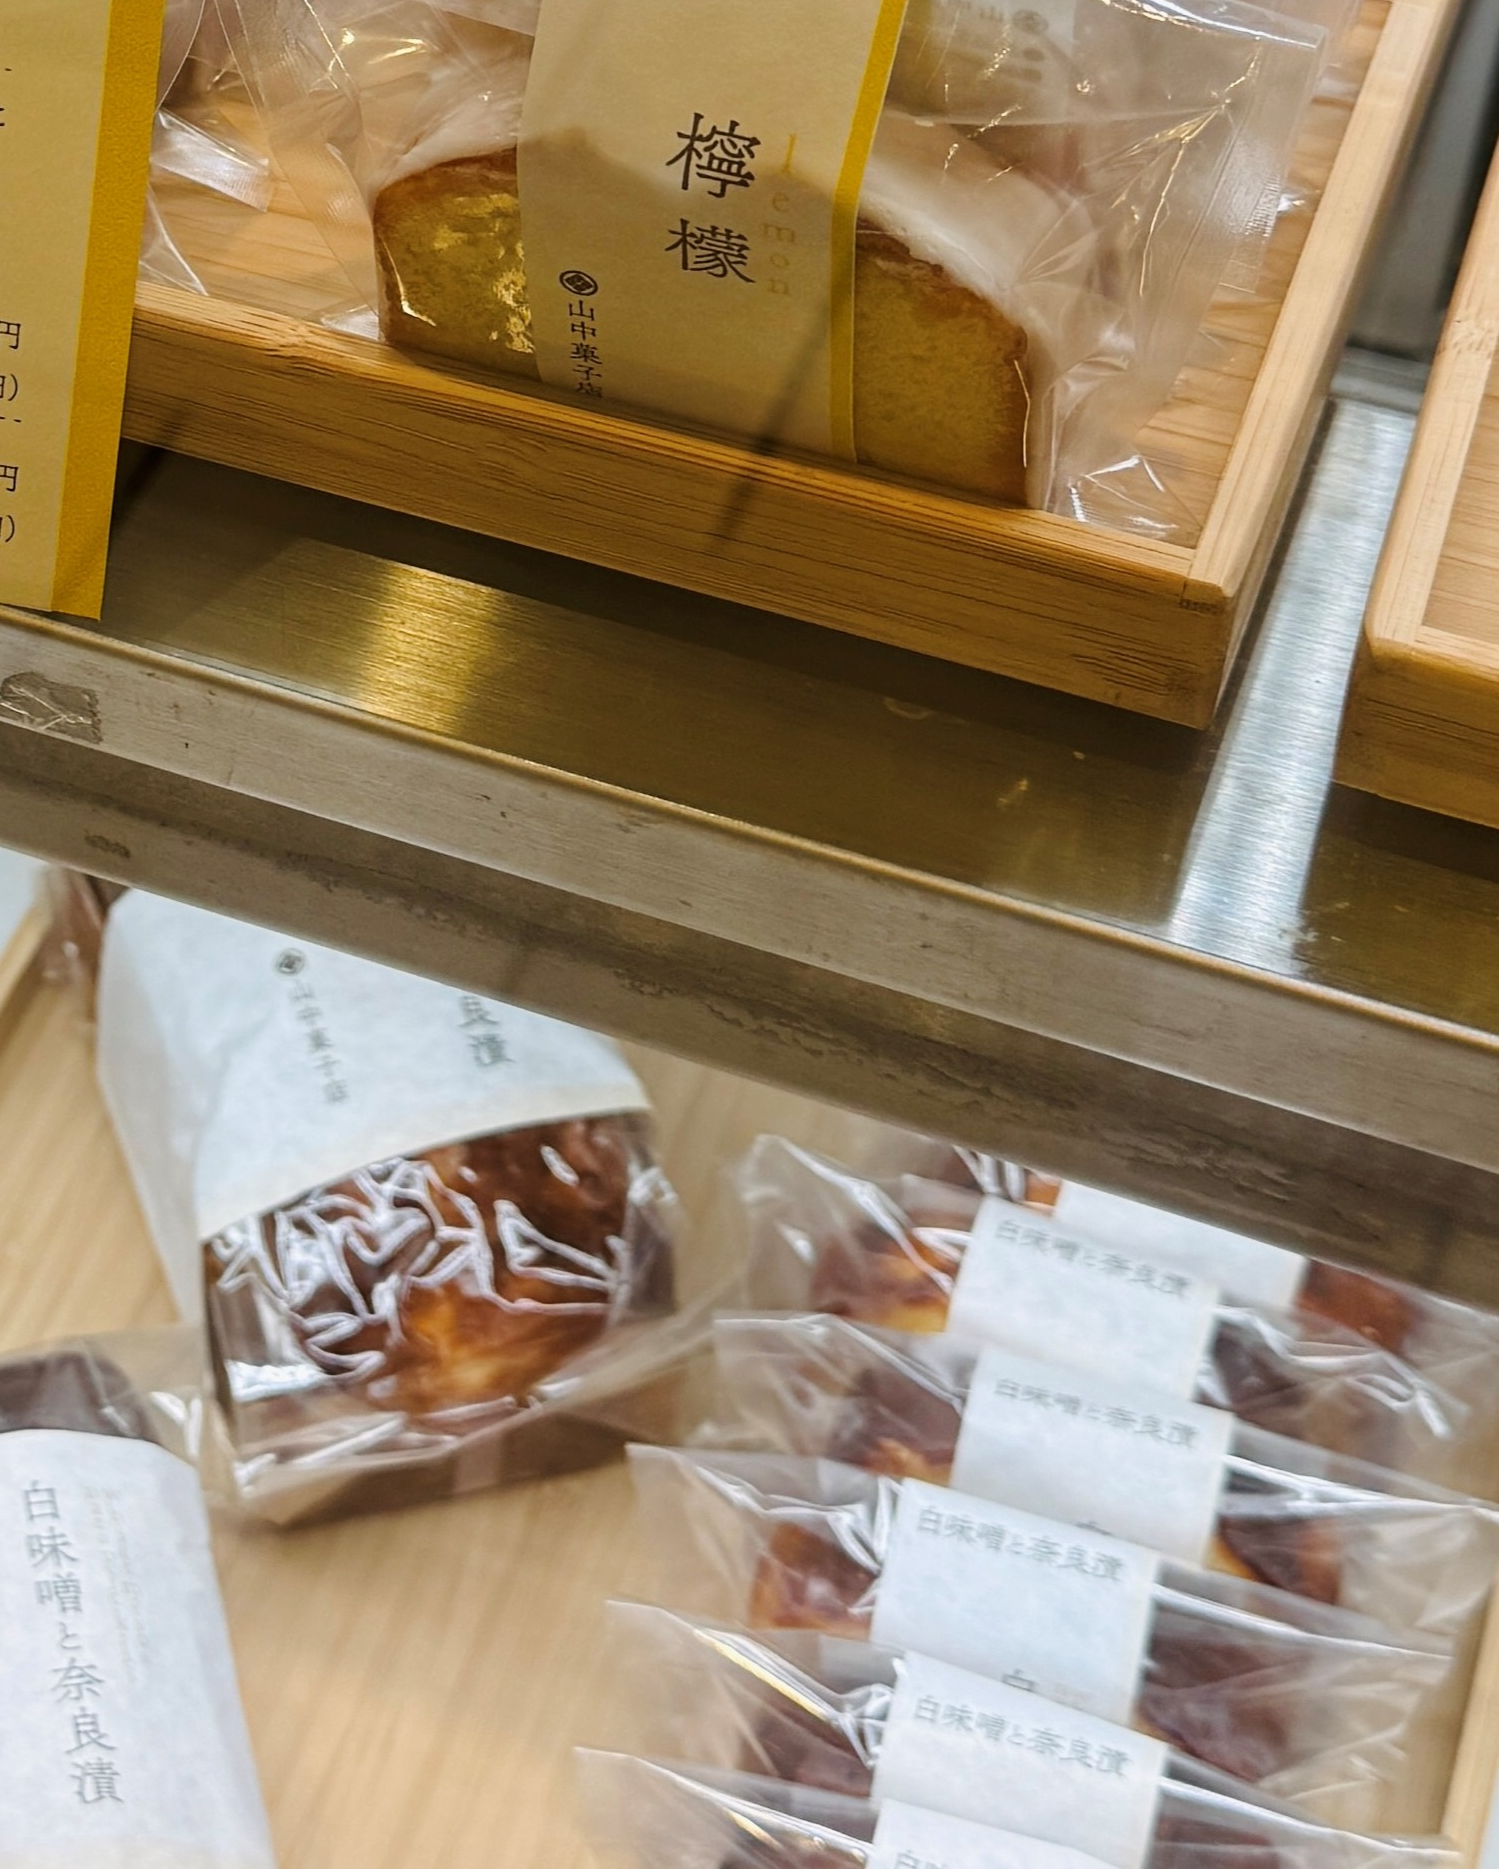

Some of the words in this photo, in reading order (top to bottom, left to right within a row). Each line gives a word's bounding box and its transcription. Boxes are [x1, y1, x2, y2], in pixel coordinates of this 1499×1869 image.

[663, 111, 763, 284] 檸檬
[759, 132, 798, 298] lemon
[22, 1479, 125, 1806] 白味噌と奈良漬
[911, 1693, 1133, 1781] 白味噌と奈良漬
